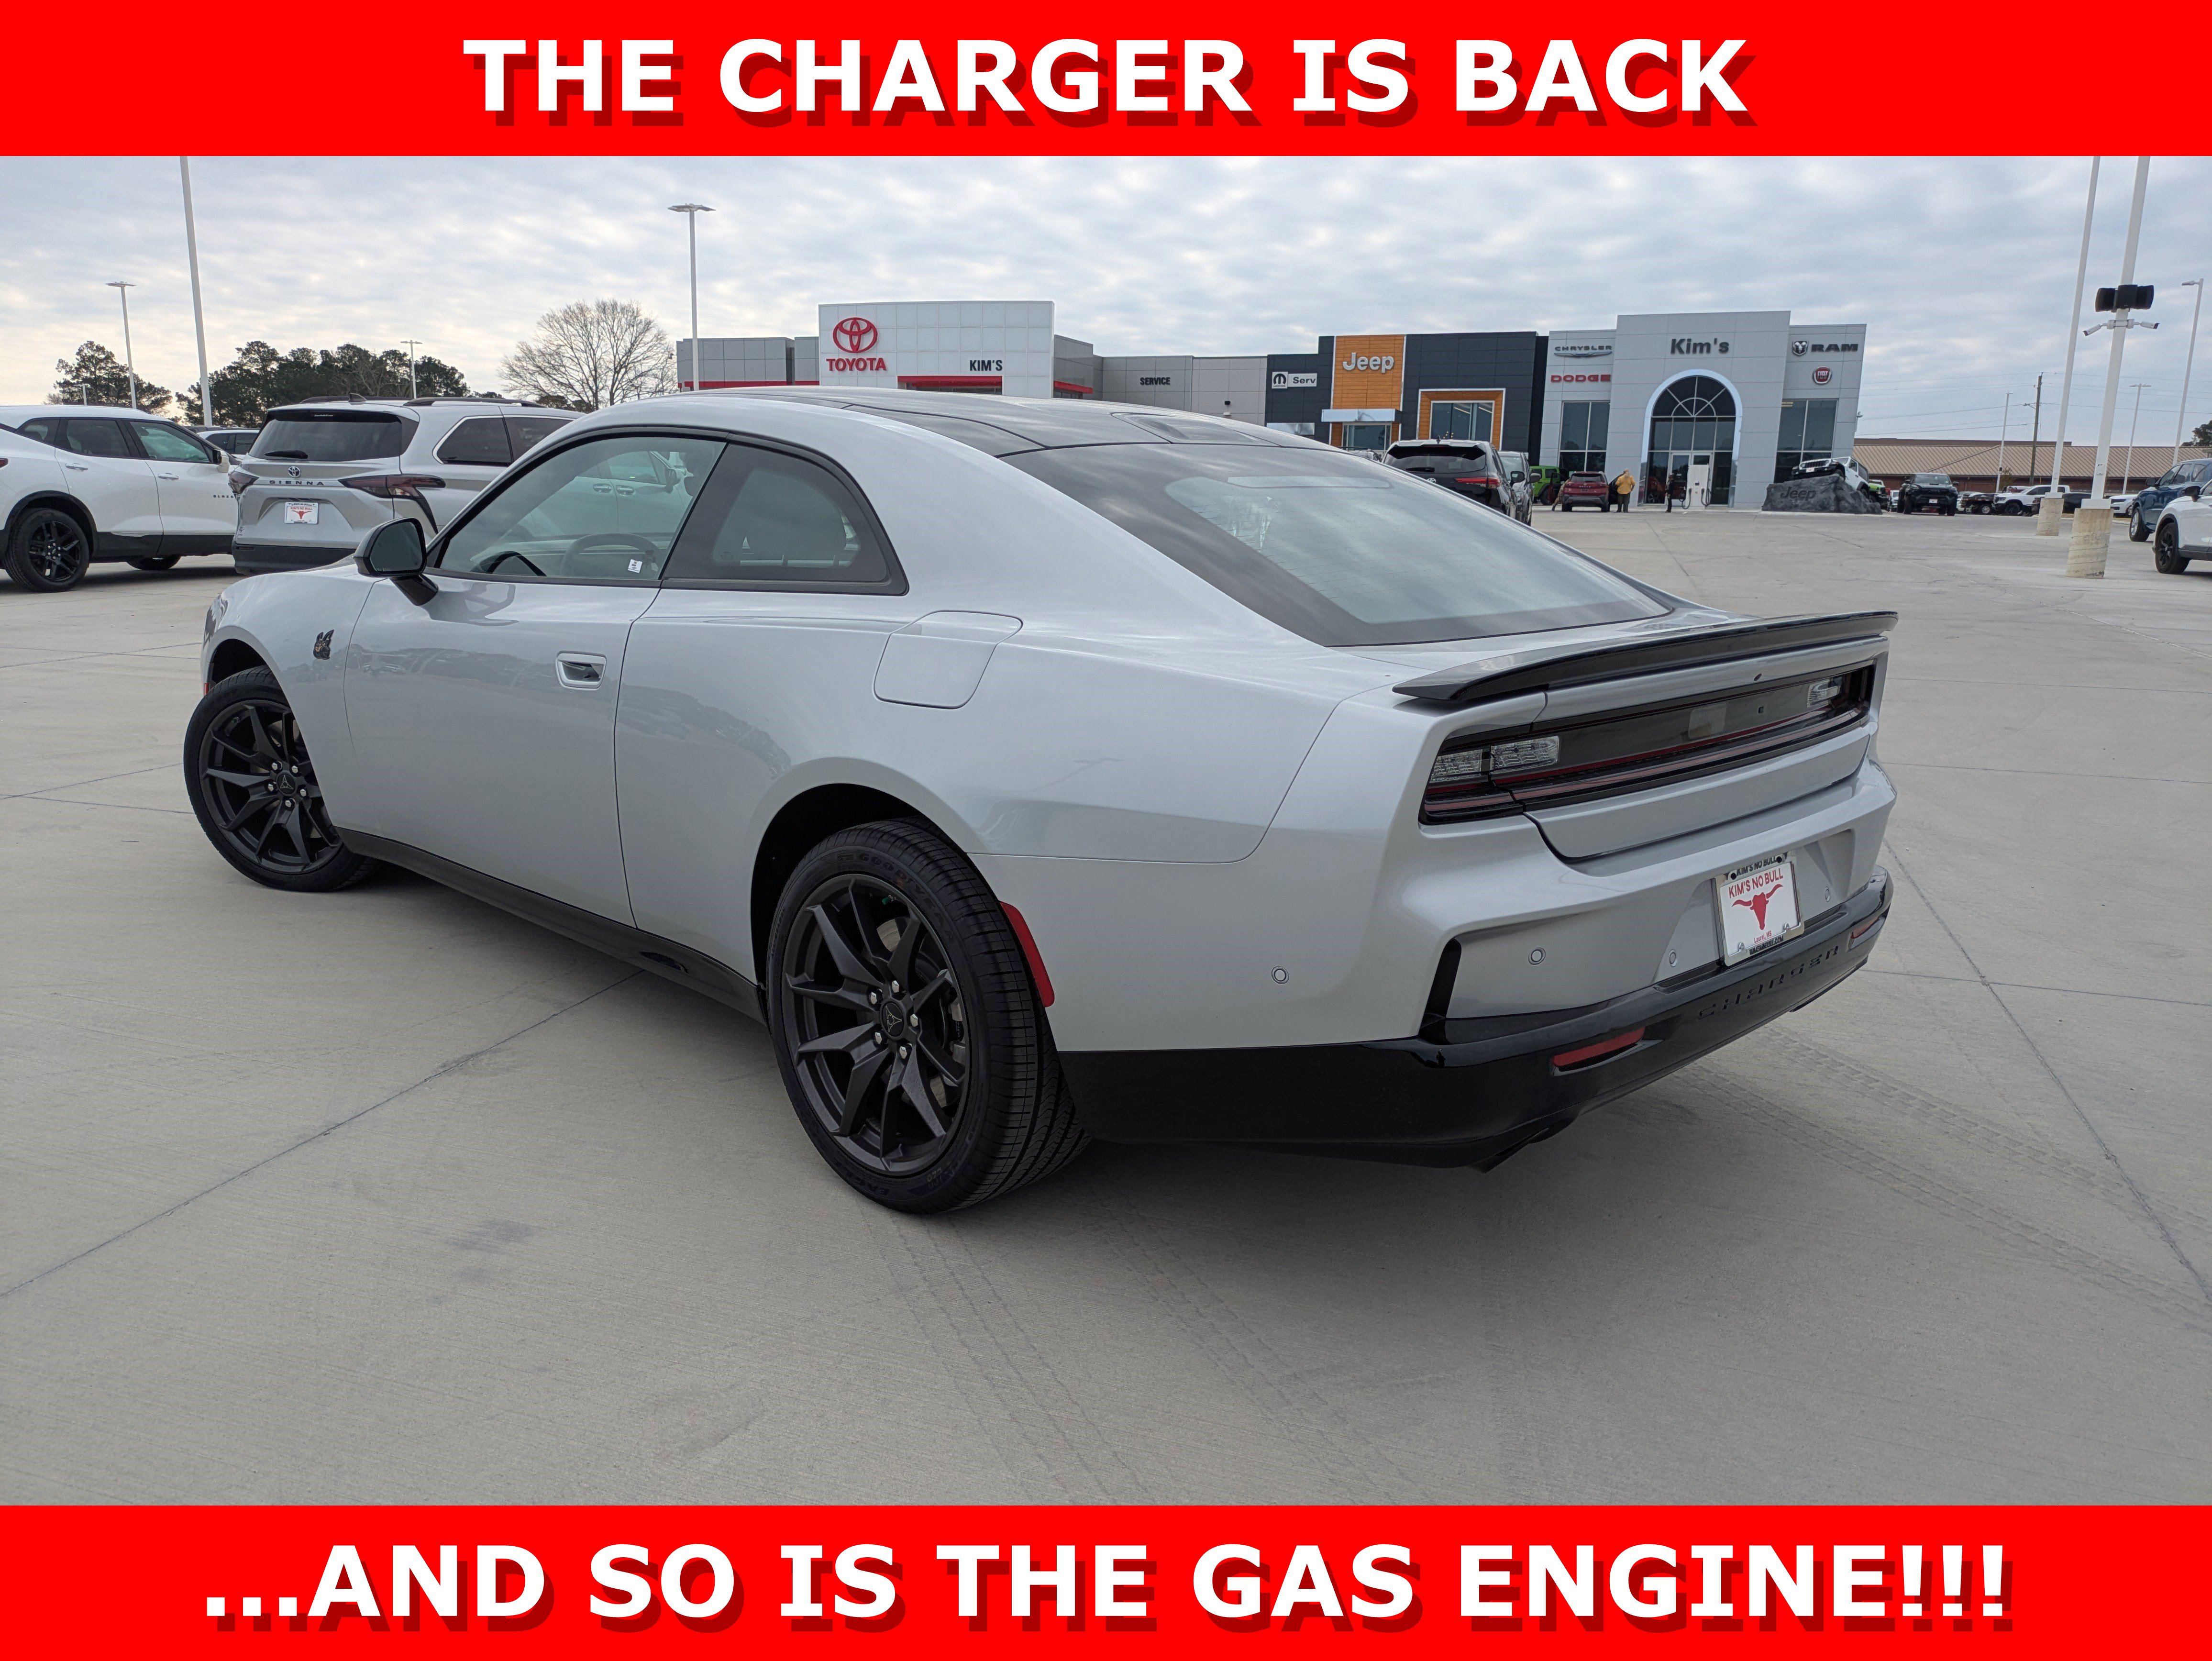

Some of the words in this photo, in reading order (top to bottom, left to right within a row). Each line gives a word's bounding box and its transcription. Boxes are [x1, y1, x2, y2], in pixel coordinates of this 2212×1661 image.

[1670, 338, 1730, 354] Kim's
[1811, 343, 1858, 353] RAM
[826, 357, 887, 372] TOYOTA
[970, 360, 1003, 371] KIM'S
[1343, 352, 1394, 373] Jeep
[1140, 377, 1171, 385] SERVICE
[1780, 486, 1817, 501] Jeep
[1736, 864, 1753, 876] KIM'S
[1753, 861, 1762, 870] NO
[1728, 879, 1751, 898] KIM'S
[1752, 875, 1764, 889] NO
[1764, 868, 1783, 885] BULL
[1754, 933, 1766, 943] Laurel,
[1699, 945, 1839, 1019] CHARGER
